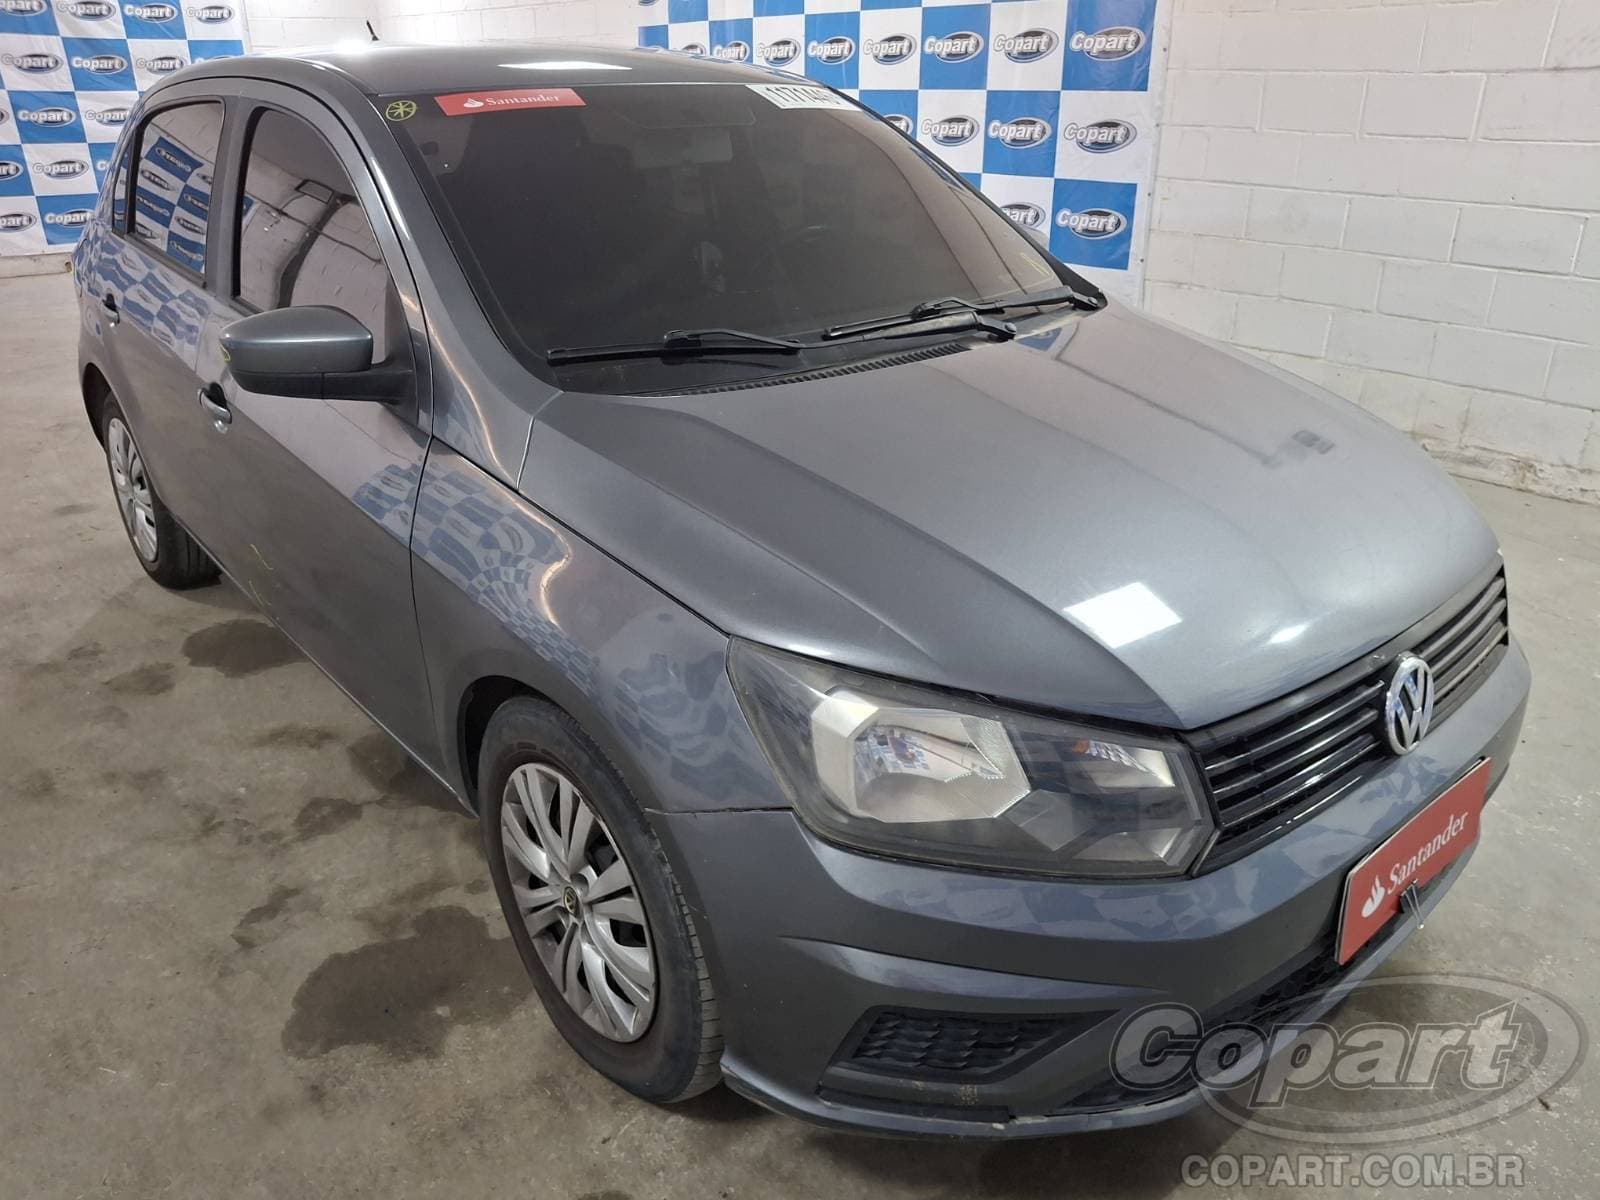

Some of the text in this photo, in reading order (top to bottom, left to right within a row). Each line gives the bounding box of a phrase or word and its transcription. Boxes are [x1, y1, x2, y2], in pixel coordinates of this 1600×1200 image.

[0, 0, 42, 11] opart
[124, 4, 172, 19] Copart
[186, 7, 229, 20] Copart
[757, 42, 795, 61] Copart
[807, 40, 850, 62] Copart
[863, 38, 909, 58] Copart
[924, 36, 977, 57] Copart
[993, 34, 1048, 57] Copart
[1070, 30, 1137, 54] Copart
[1, 53, 57, 68] Copart
[72, 56, 122, 71] Copart
[136, 57, 180, 70] Copart
[486, 94, 560, 107] Santander
[18, 109, 69, 124] Copart
[921, 118, 974, 141] Copart
[988, 119, 1042, 142] Copart
[1064, 121, 1130, 145] Copart
[32, 162, 81, 176] Copart
[0, 215, 29, 228] part
[1056, 208, 1118, 232] Copart
[1387, 811, 1469, 895] Santander
